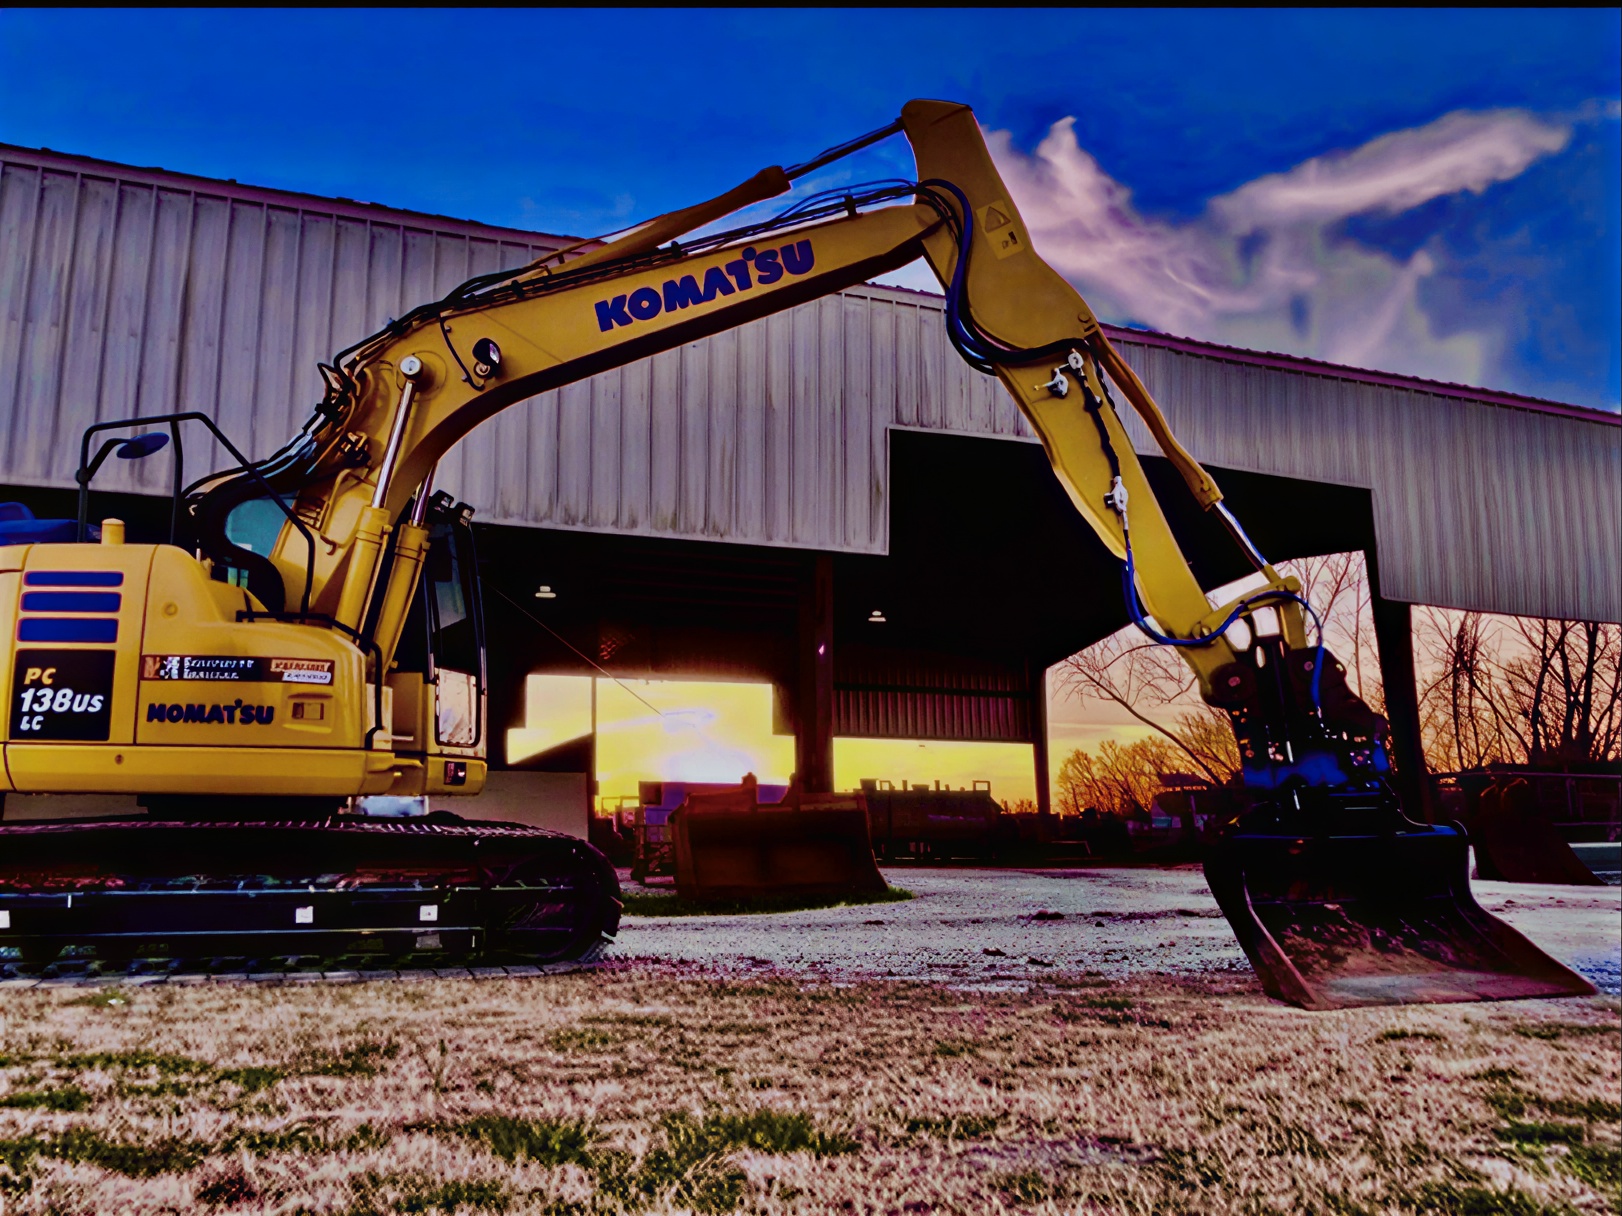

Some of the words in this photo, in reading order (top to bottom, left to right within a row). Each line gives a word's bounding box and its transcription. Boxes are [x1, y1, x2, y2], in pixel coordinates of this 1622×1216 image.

[594, 238, 816, 332] KOMATSU
[23, 667, 57, 685] PC
[21, 687, 104, 713] 138US
[146, 698, 275, 725] KOMATSU
[20, 715, 44, 731] LC
